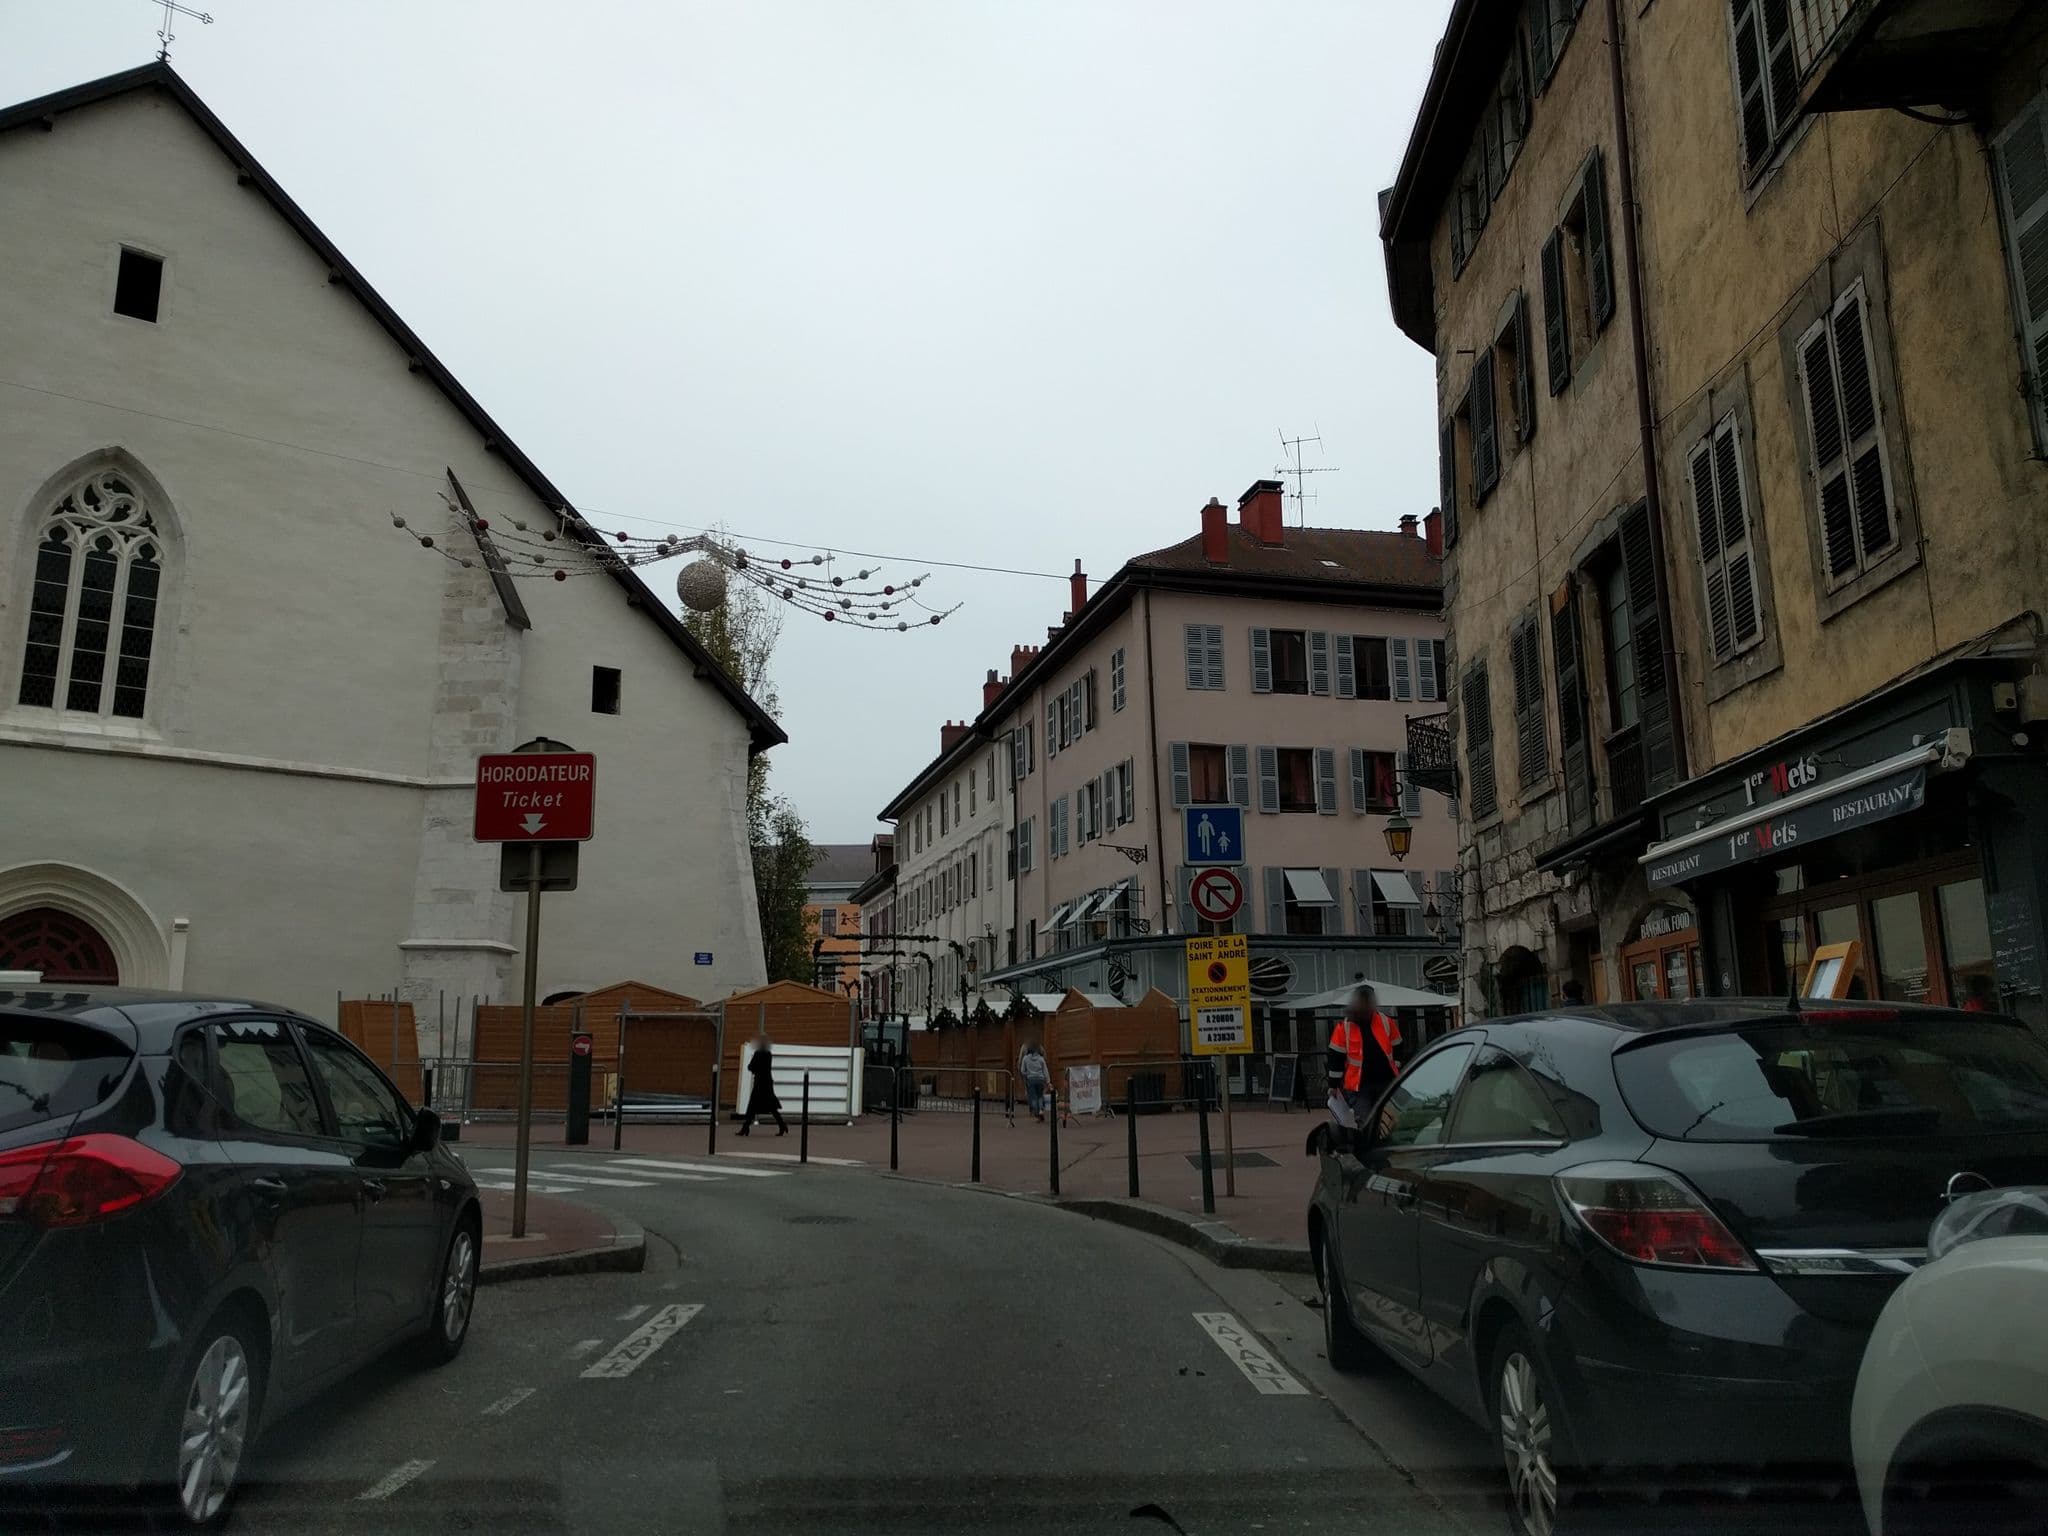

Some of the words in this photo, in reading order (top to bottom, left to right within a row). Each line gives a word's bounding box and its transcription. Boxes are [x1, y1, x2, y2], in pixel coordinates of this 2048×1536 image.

[481, 765, 590, 783] HORODATEUR
[1743, 771, 1764, 807] 1er
[1771, 756, 1817, 793] Mets
[503, 791, 563, 808] Ticket
[1832, 782, 1912, 822] RESTAURANT
[1728, 831, 1750, 860] 1er
[1754, 820, 1797, 850] Mets
[1652, 854, 1700, 881] RESTAURANT
[1640, 918, 1671, 939] BANGKOK
[1671, 912, 1690, 931] FOOD
[1189, 941, 1213, 950] FOIRE
[1218, 939, 1228, 948] DE
[1233, 938, 1244, 947] LA
[1188, 952, 1212, 961] SAINT
[1191, 985, 1246, 994] STATIONNEMENT
